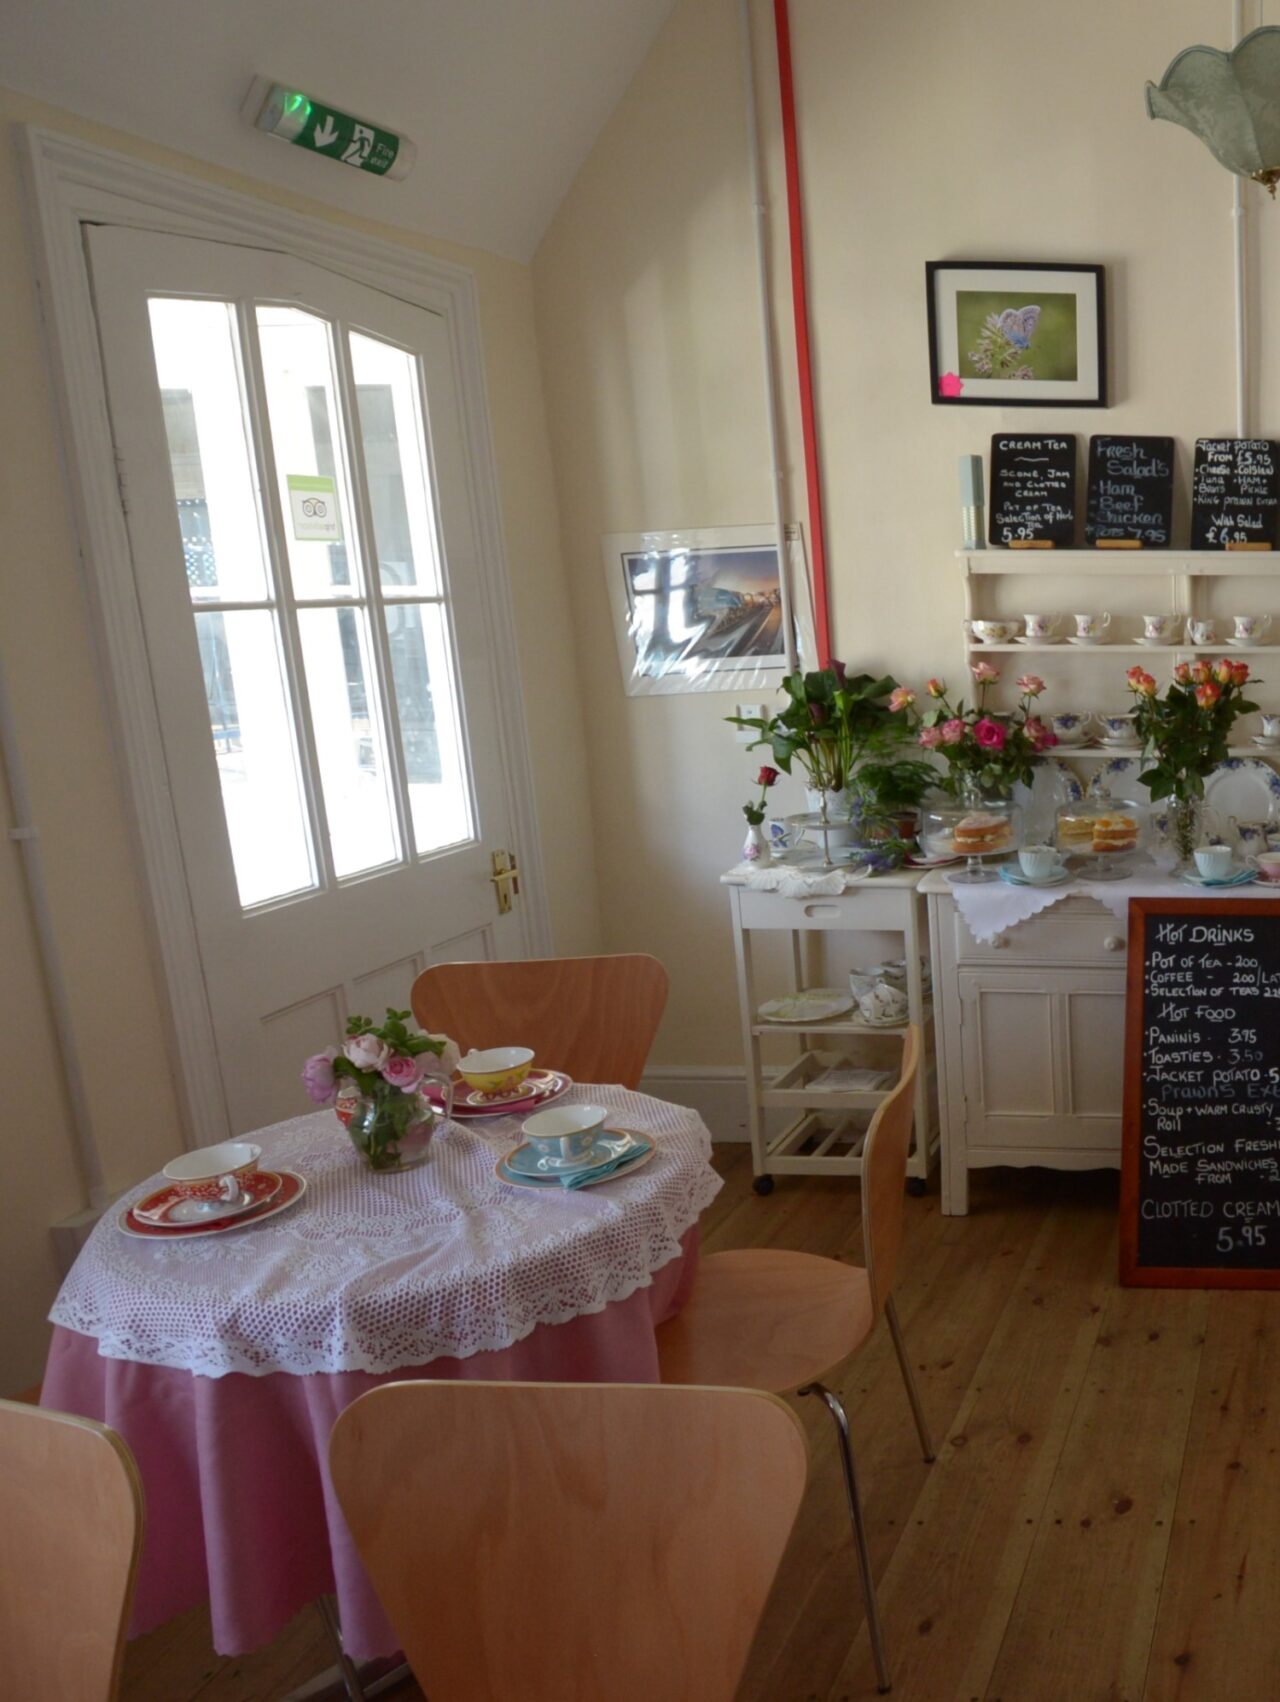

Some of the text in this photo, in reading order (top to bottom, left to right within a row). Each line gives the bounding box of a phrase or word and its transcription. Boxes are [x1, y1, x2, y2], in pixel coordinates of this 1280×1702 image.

[375, 142, 395, 159] Fire
[999, 440, 1042, 451] CREAM
[1237, 450, 1272, 466] £5.95
[1099, 479, 1136, 496] Ham
[1099, 495, 1145, 512] Beef
[1001, 527, 1035, 543] 5.95
[1127, 526, 1167, 543] 7.95
[1151, 951, 1177, 969] POT
[1180, 955, 1195, 968] OF
[1199, 953, 1223, 969] TEA
[1150, 971, 1194, 984] COFFEE
[1194, 1005, 1237, 1020] FOOD
[1227, 1048, 1264, 1065] 3.50
[1146, 1065, 1205, 1082] JACKET
[1157, 1116, 1182, 1132] Roll
[1143, 1135, 1226, 1159] SELECTION
[1149, 1157, 1279, 1177] MADE SANDWICHES
[1194, 1172, 1233, 1185] FROM
[1141, 1198, 1215, 1220] CLOTTED
[1216, 1224, 1268, 1252] 5.95
